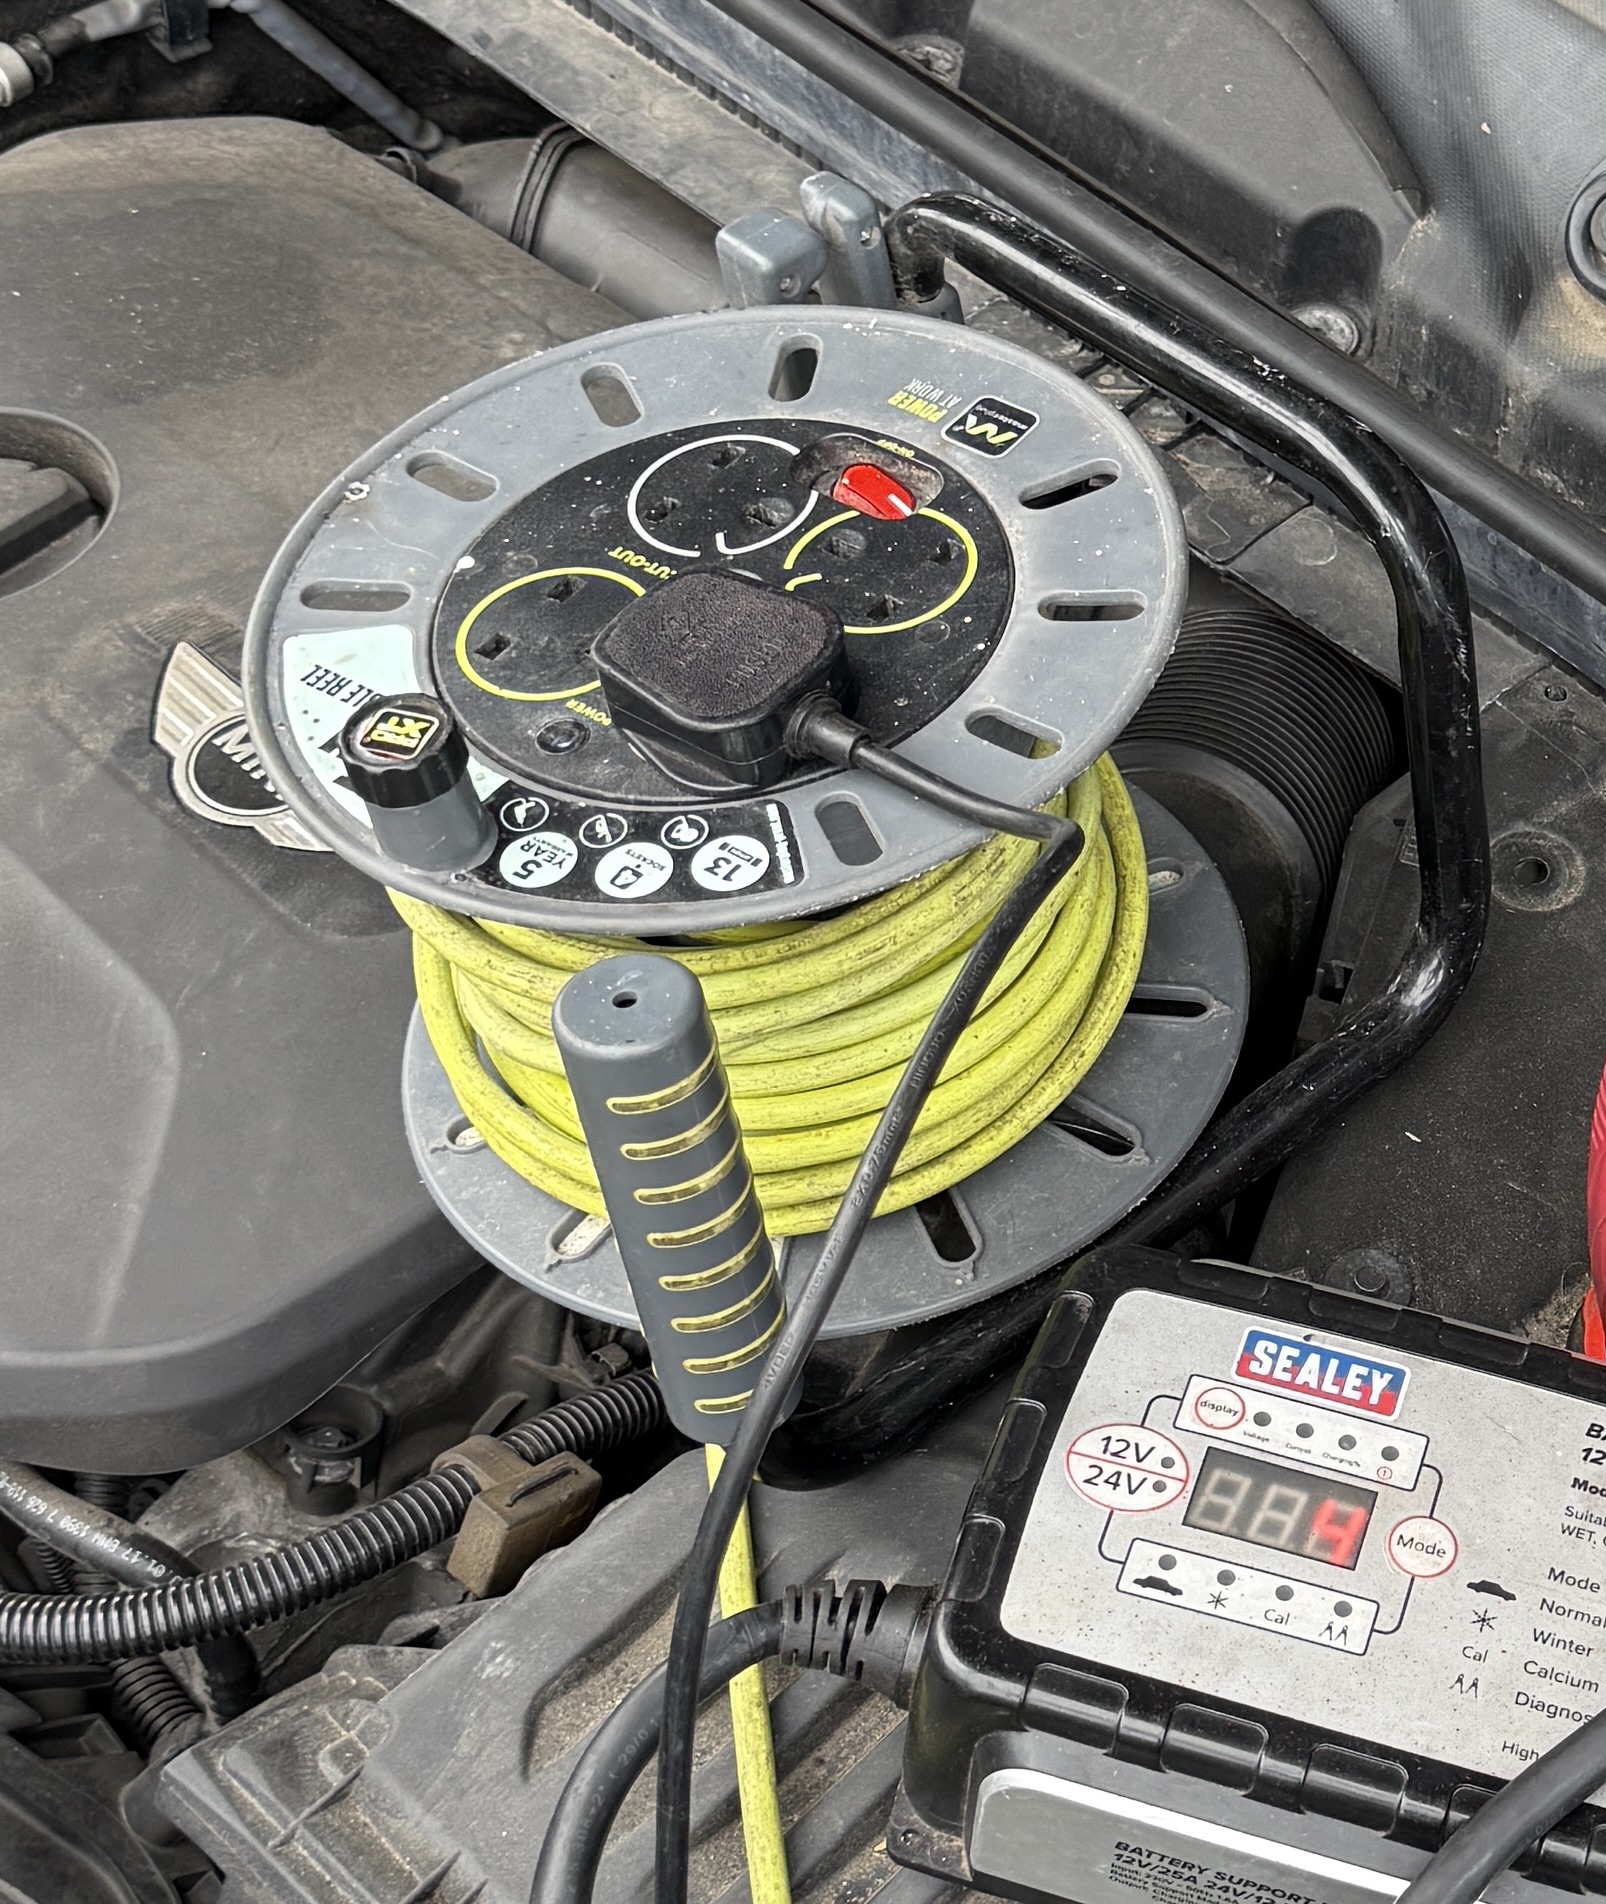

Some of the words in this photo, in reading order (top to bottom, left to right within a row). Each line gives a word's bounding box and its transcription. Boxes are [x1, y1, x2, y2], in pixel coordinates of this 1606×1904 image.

[903, 377, 944, 402] WORK
[888, 391, 948, 423] POWER
[300, 664, 347, 696] REEL
[565, 698, 612, 727] POWER
[519, 839, 567, 869] YEAR
[512, 859, 543, 881] 5
[703, 856, 743, 883] 13
[1248, 1339, 1396, 1406] SEALEY
[1200, 1399, 1240, 1417] display
[1101, 1436, 1155, 1464] 12V
[1083, 1464, 1148, 1495] 24V
[1396, 1534, 1447, 1558] Mode
[1547, 1567, 1601, 1593] Mode
[1263, 1608, 1291, 1626] Cal
[1462, 1645, 1489, 1663] Cal
[1532, 1627, 1595, 1658] Winter
[1523, 1660, 1600, 1693] Calcium
[1515, 1691, 1595, 1725] Diagnos
[1501, 1740, 1540, 1762] High
[1113, 1853, 1198, 1885] 12V/25A
[1114, 1841, 1212, 1875] BATTERY
